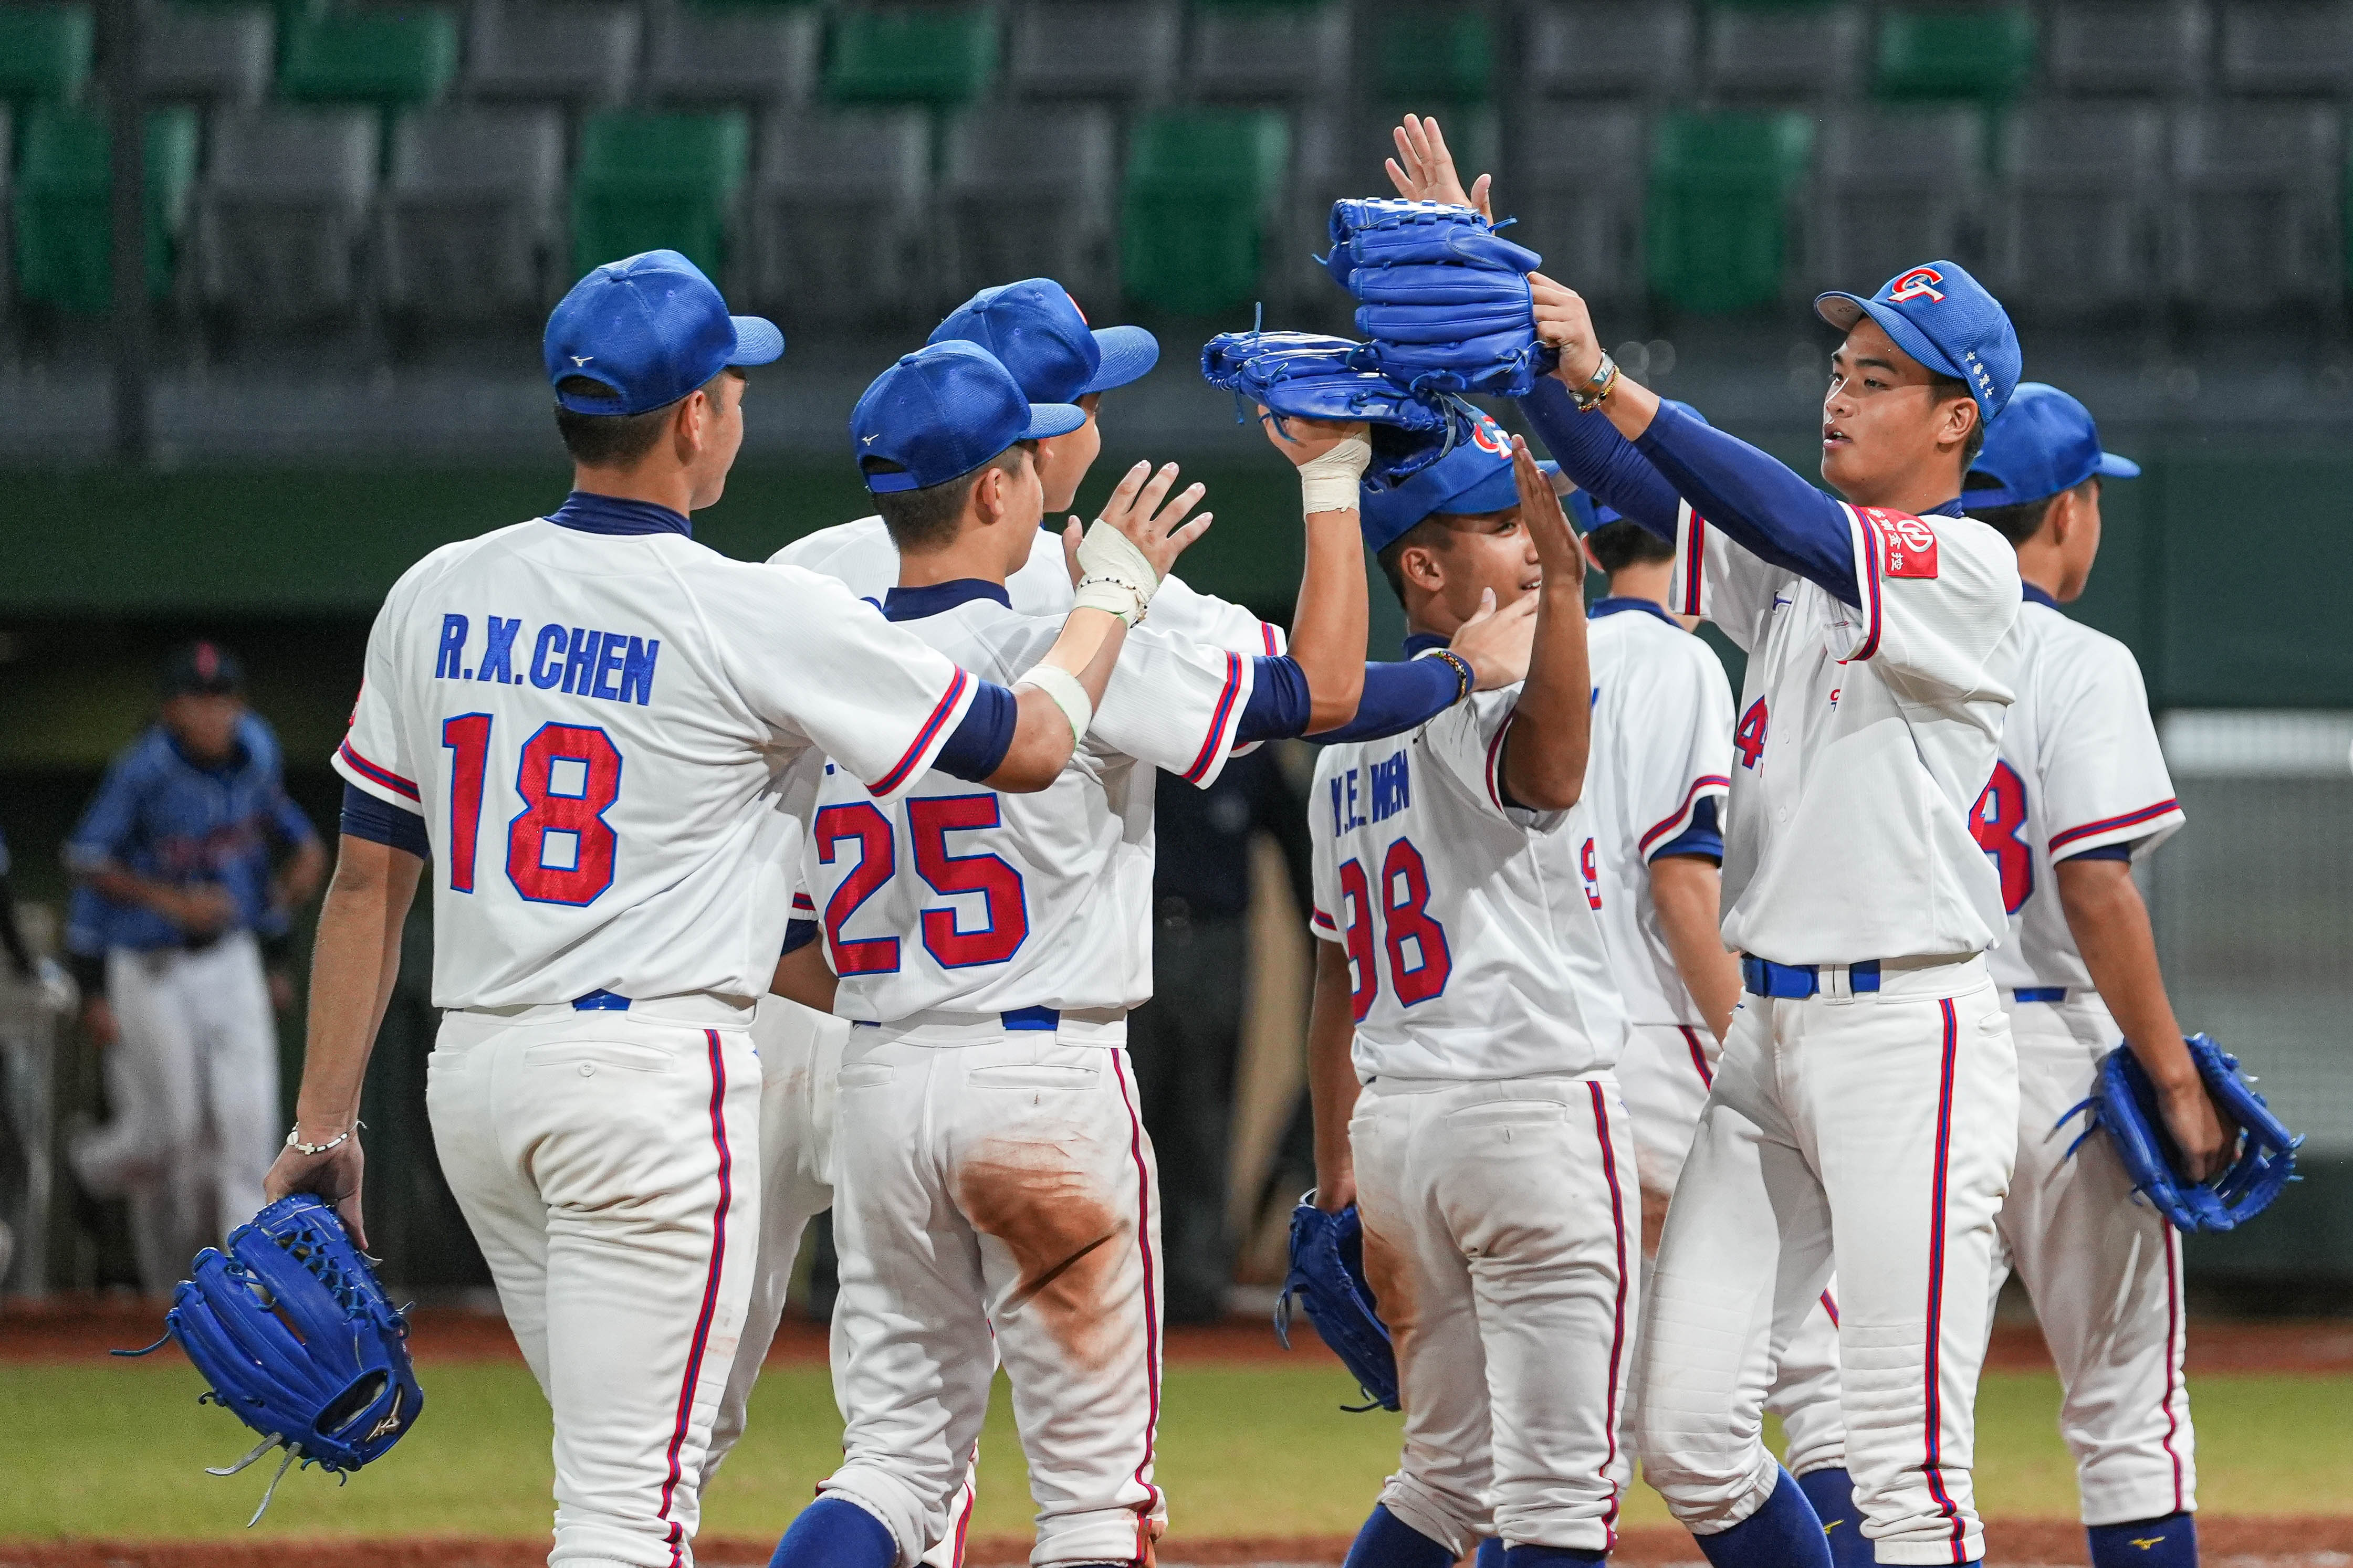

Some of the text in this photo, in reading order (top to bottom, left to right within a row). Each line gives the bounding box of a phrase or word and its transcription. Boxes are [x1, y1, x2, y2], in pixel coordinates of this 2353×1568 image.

[435, 613, 661, 706] R.X.CHEN
[442, 711, 623, 908] 18
[813, 792, 1030, 977] 25
